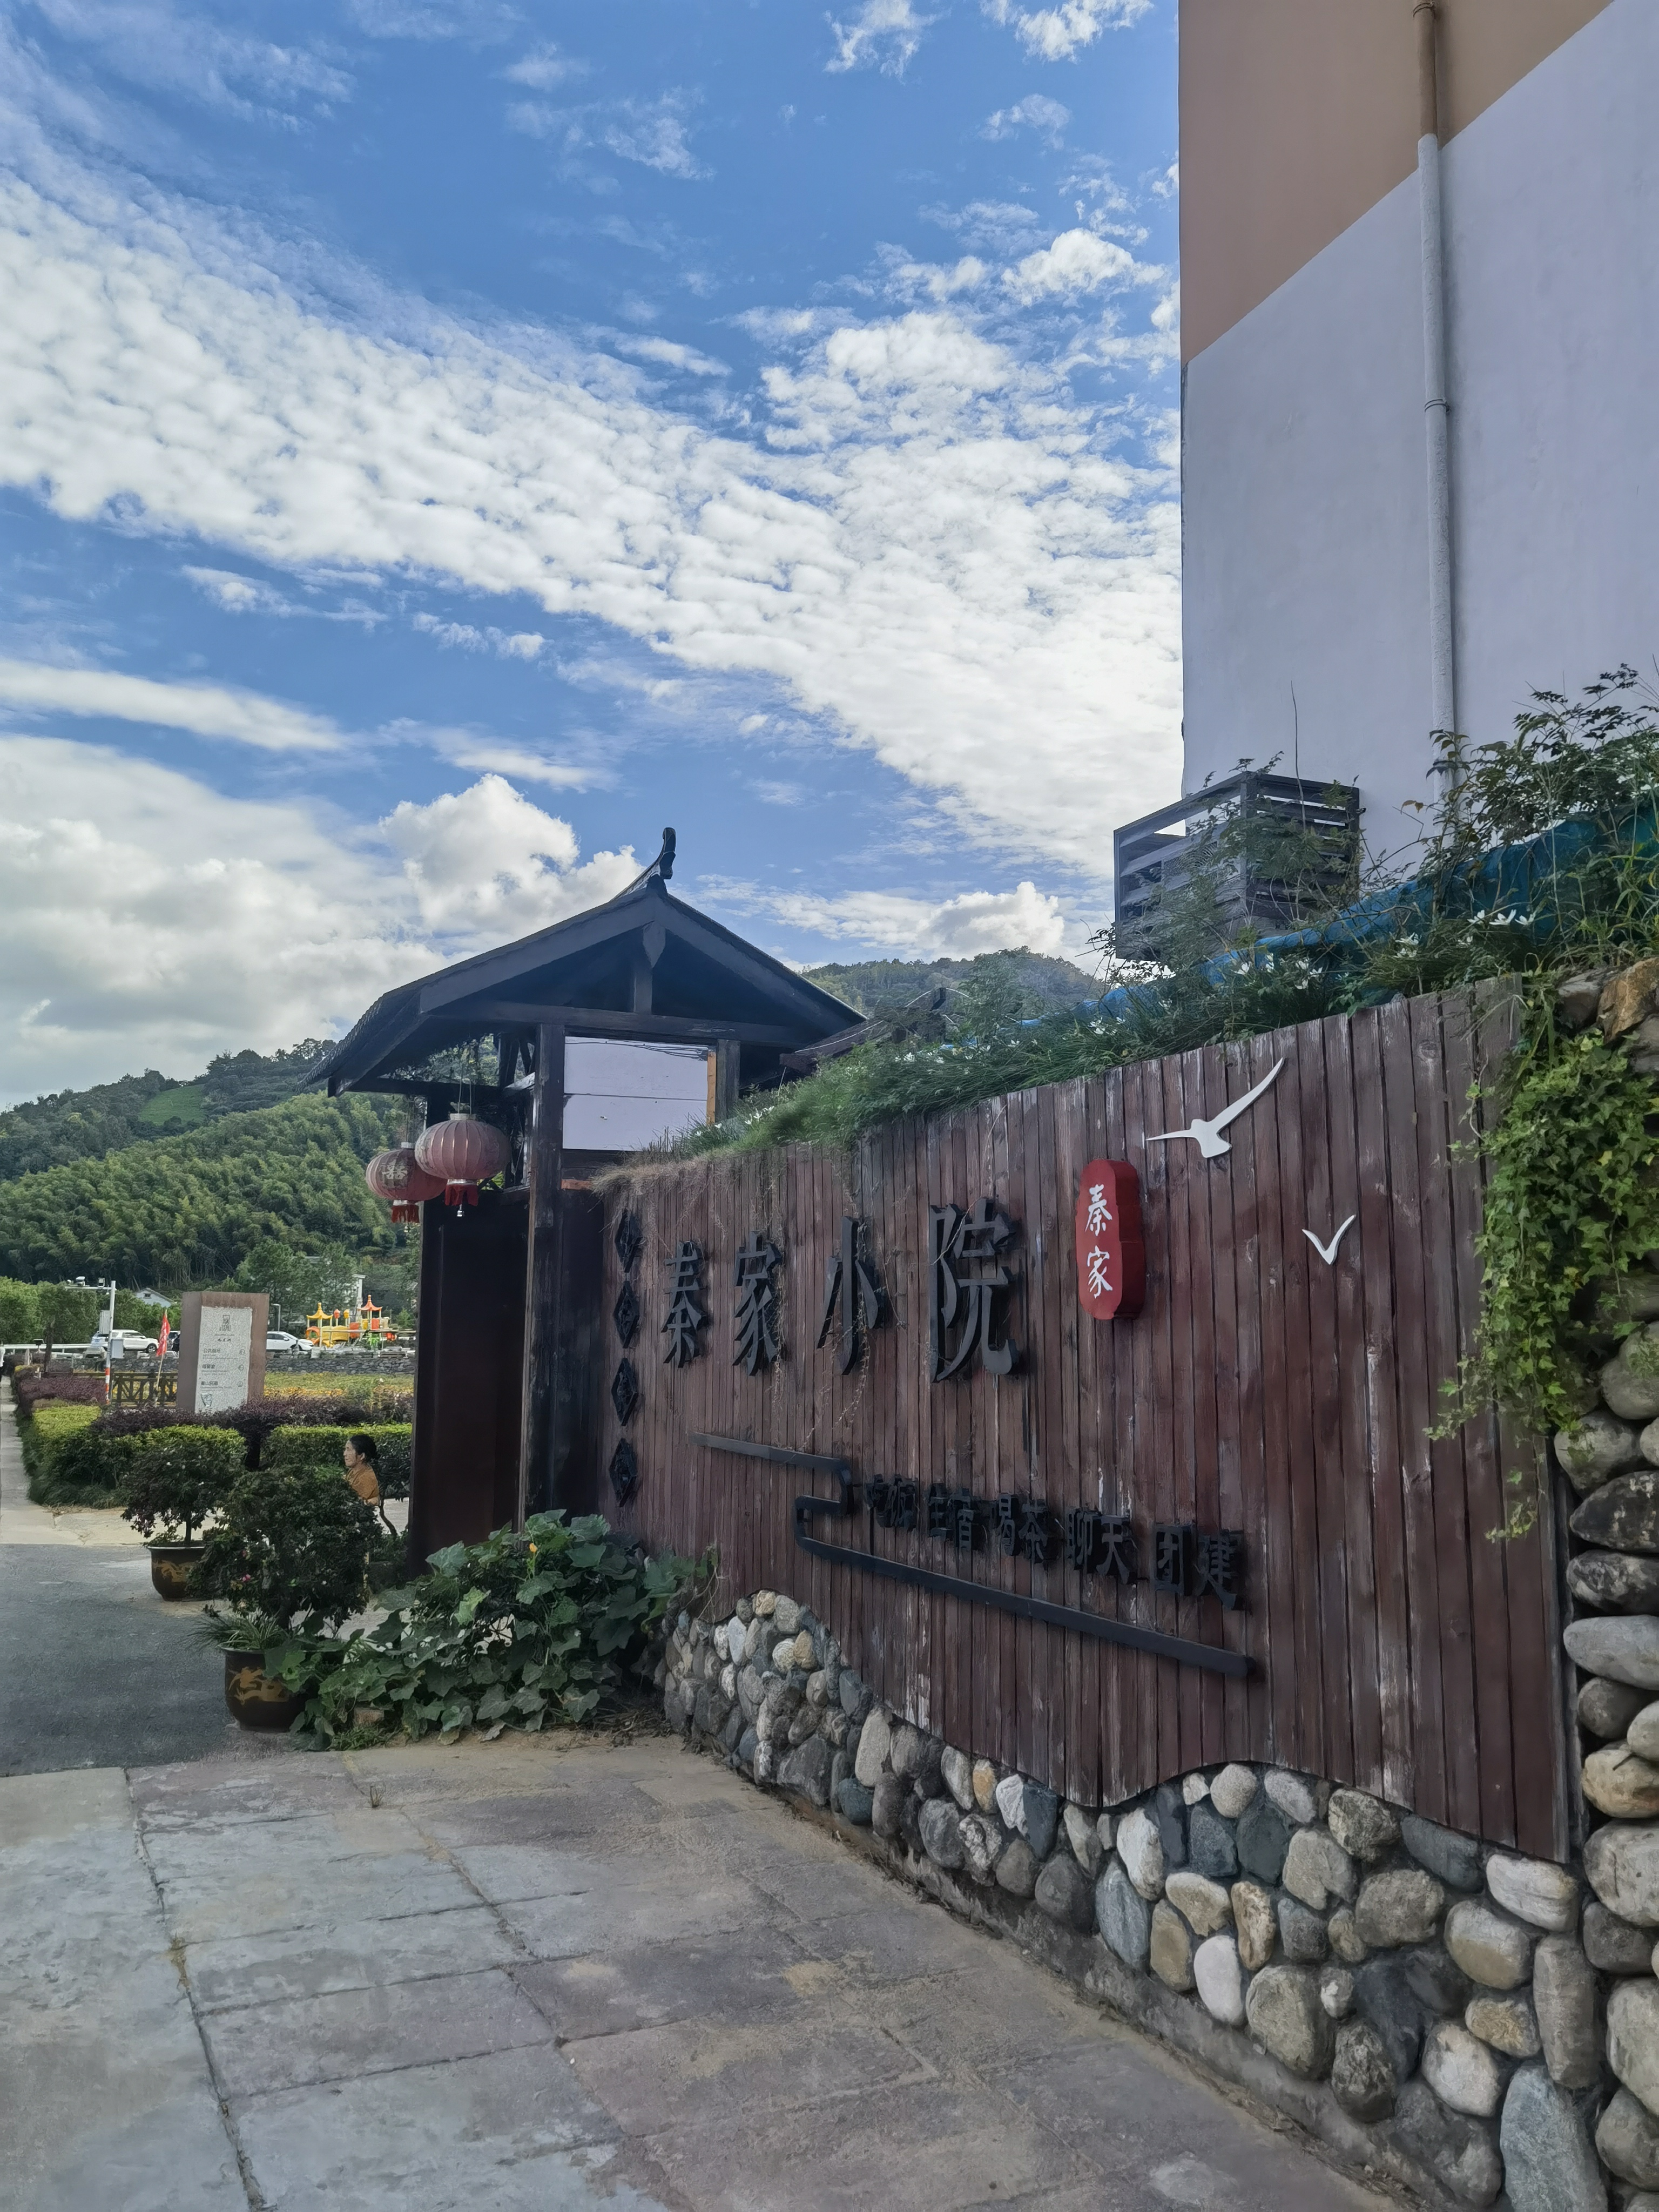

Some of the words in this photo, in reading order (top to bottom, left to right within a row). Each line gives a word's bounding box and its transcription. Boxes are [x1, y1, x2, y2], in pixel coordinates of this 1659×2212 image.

[661, 1197, 1020, 1384] 秦家小院
[1085, 1184, 1112, 1299] 秦家
